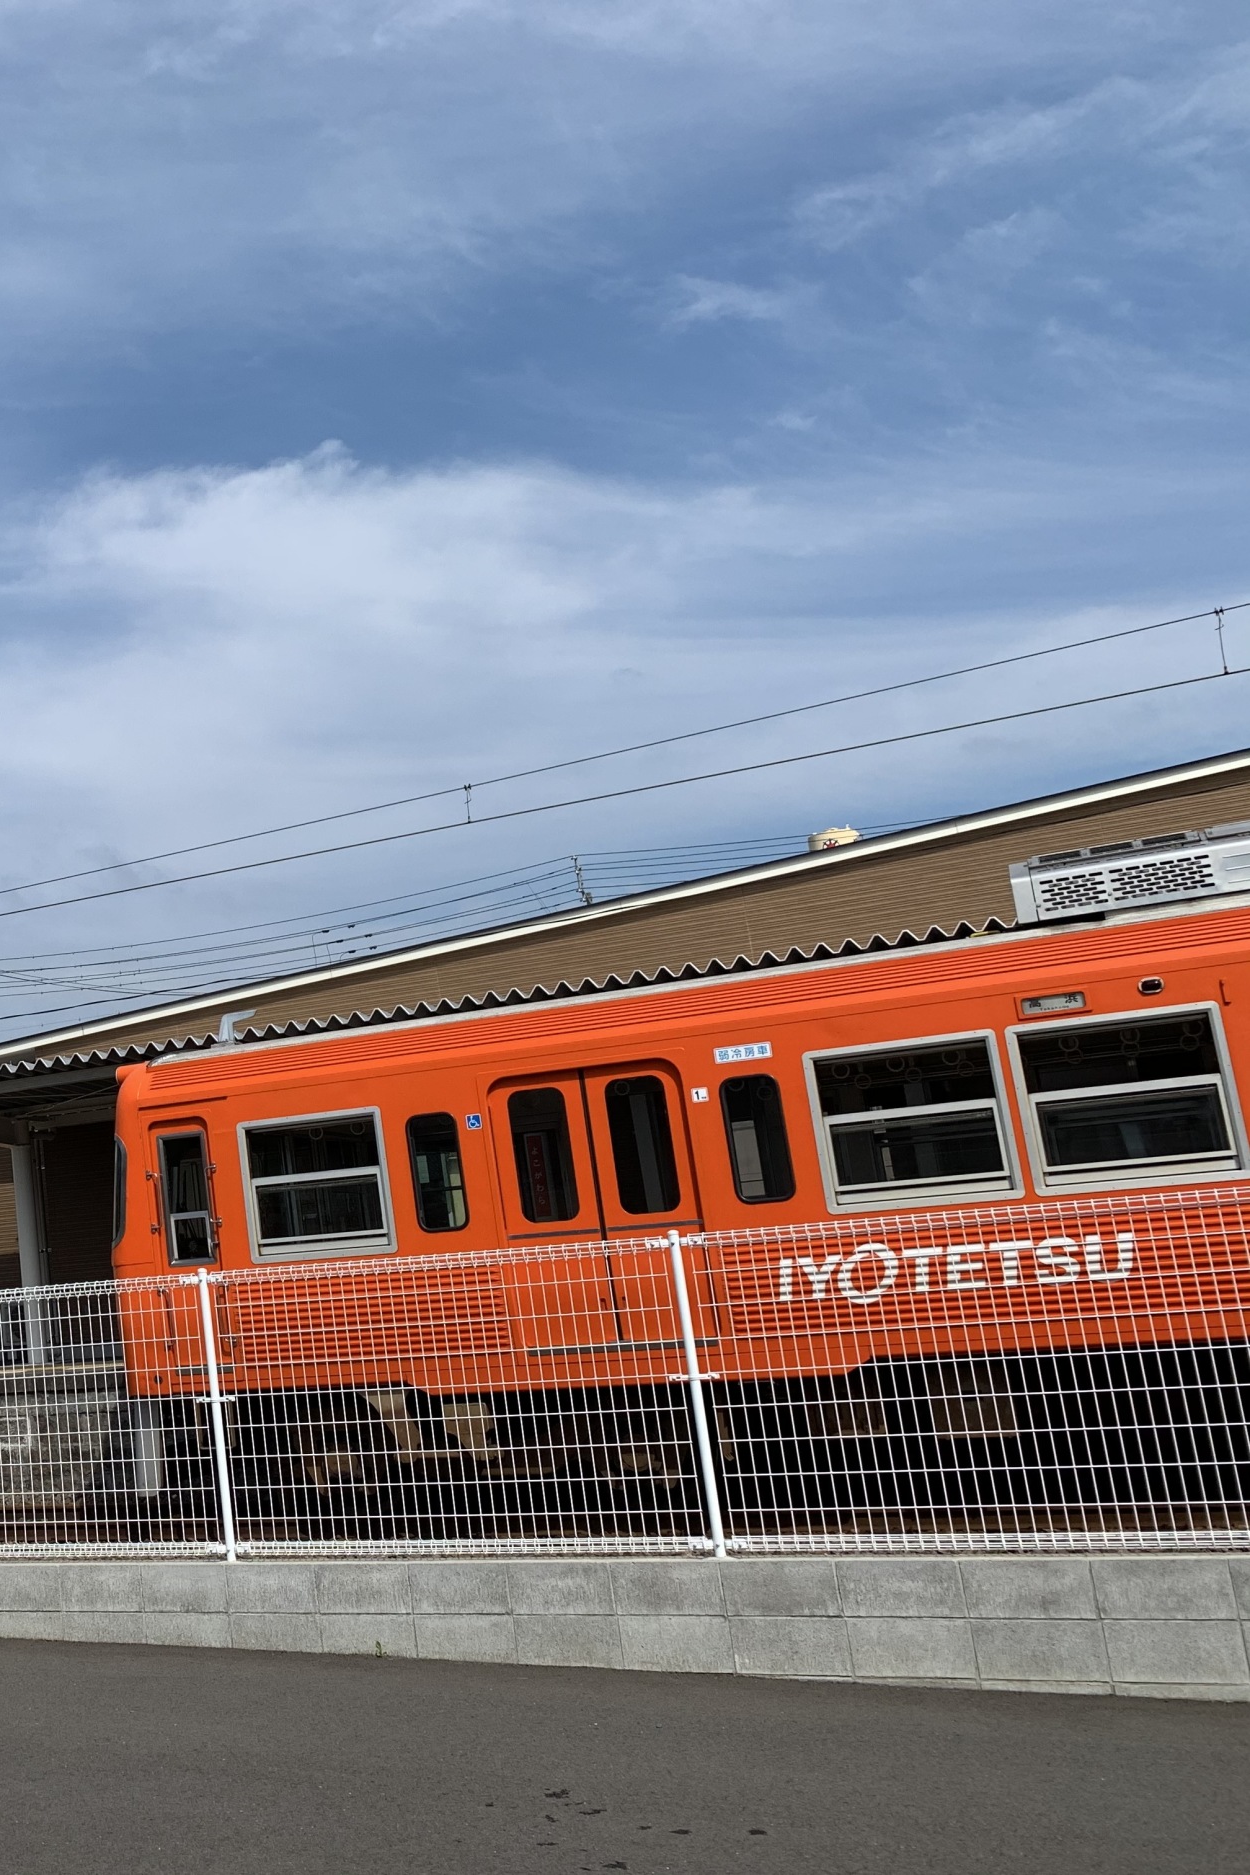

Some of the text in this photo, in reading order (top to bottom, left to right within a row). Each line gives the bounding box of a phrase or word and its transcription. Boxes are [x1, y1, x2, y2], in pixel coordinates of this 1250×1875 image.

[717, 1045, 769, 1061] 弱冷房車
[531, 1146, 547, 1205] よこがわら
[778, 1231, 1135, 1305] IYOTETSU
